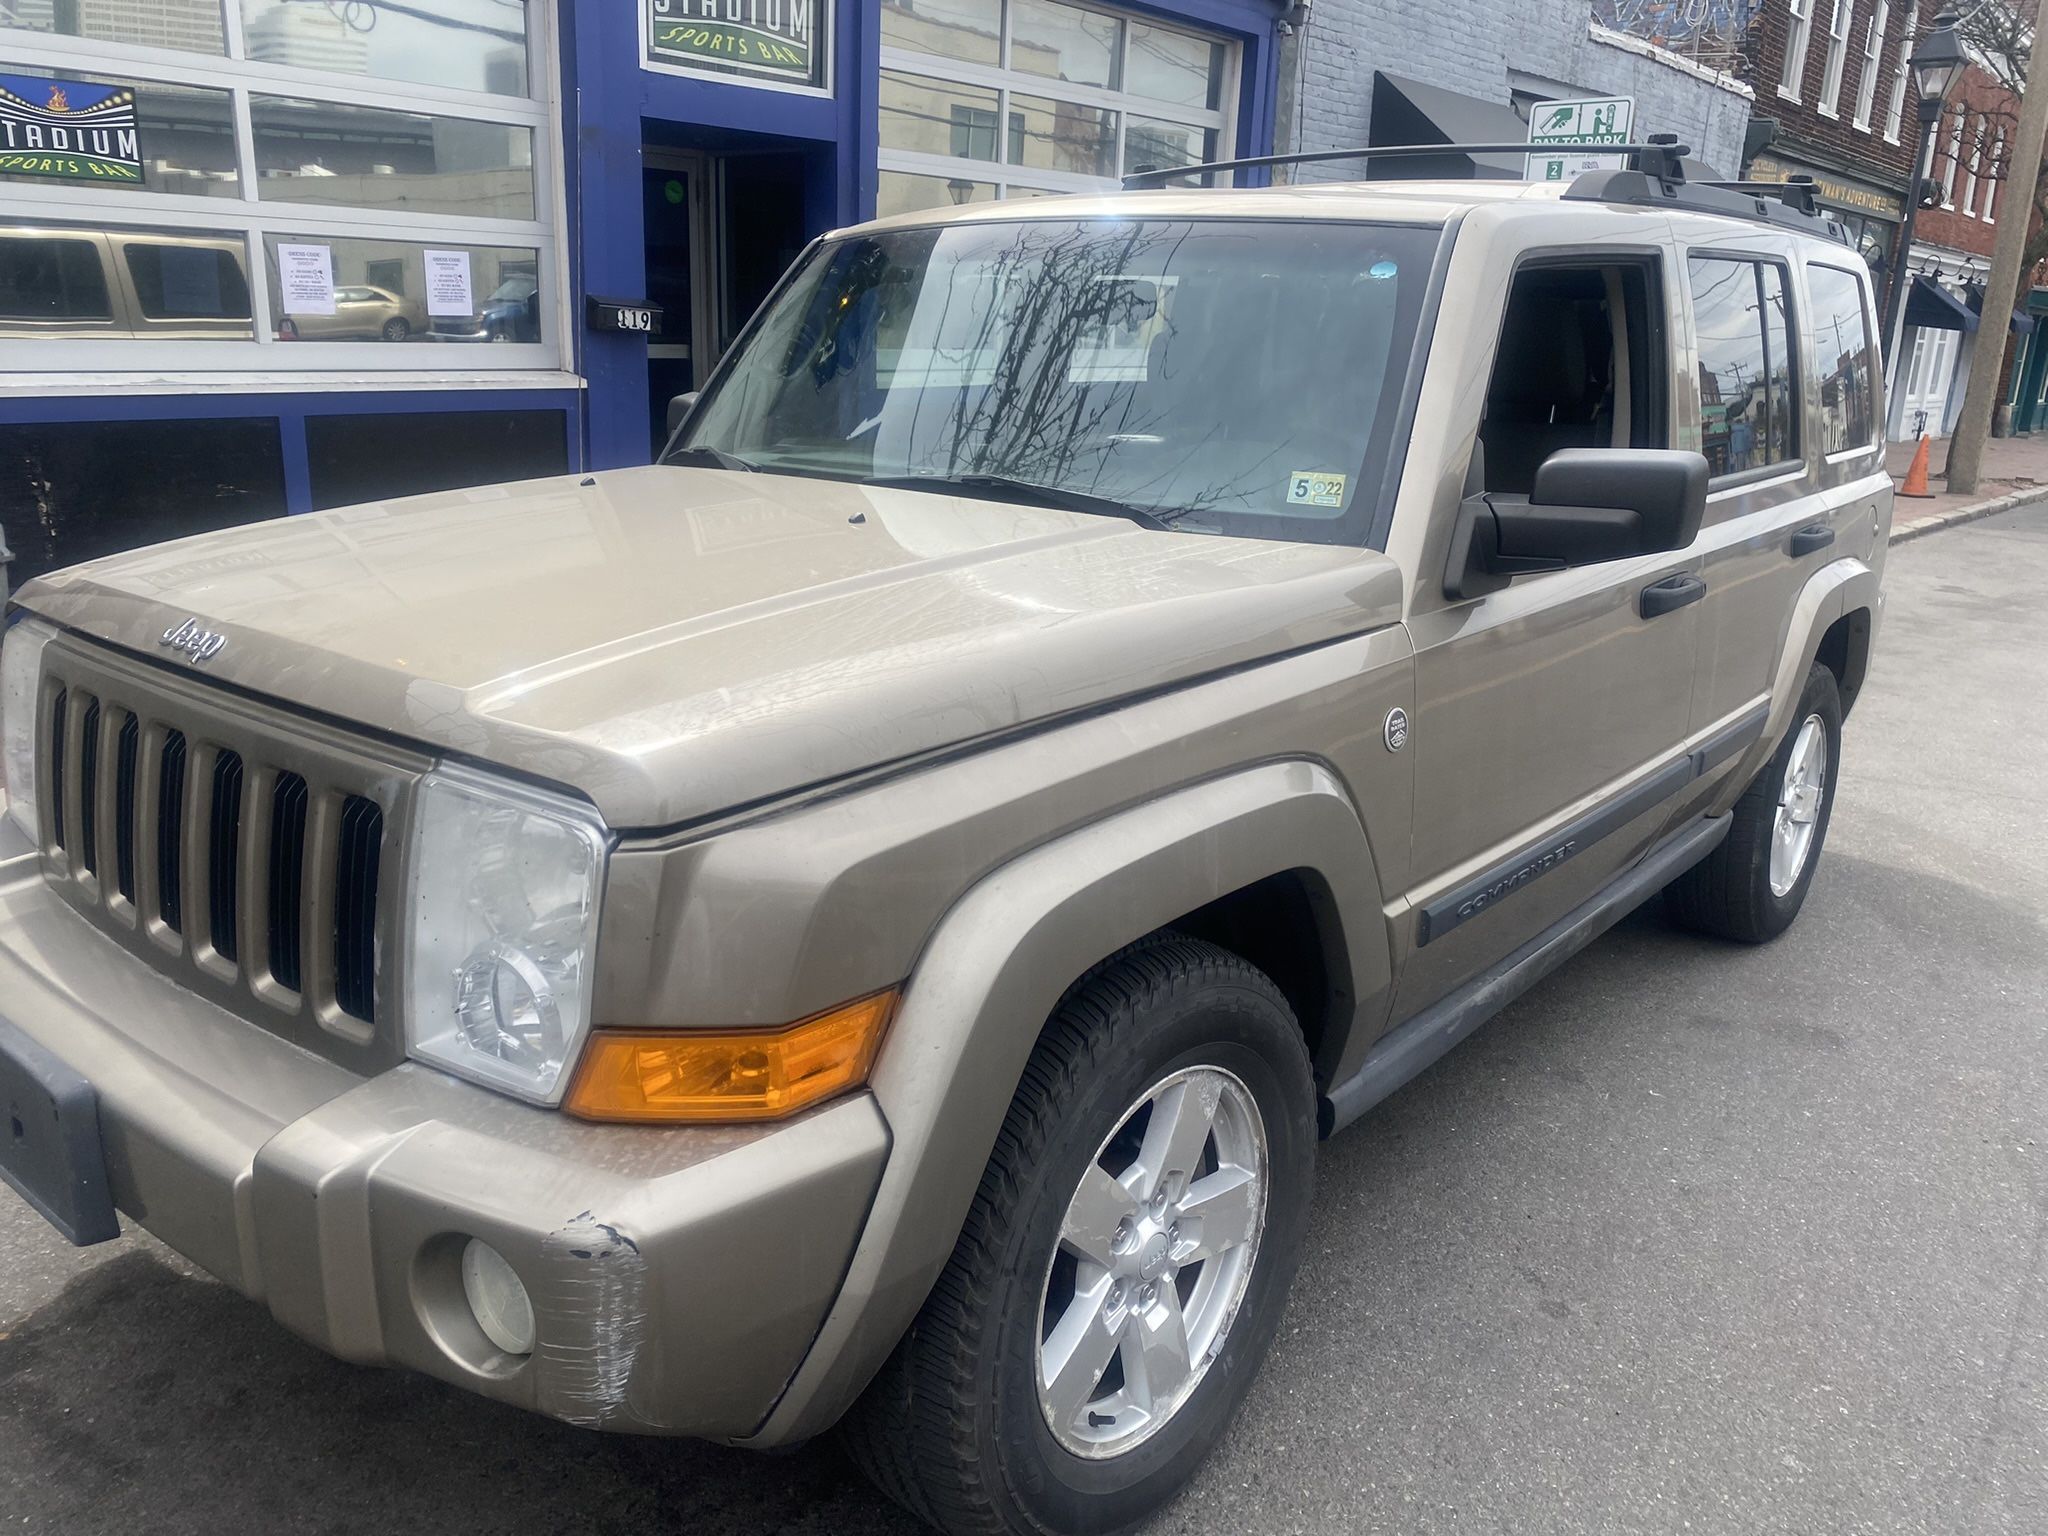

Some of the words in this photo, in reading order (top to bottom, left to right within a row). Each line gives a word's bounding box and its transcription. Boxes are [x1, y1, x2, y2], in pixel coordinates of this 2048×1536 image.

[660, 27, 748, 55] SPORTS
[757, 41, 804, 65] BAR
[0, 120, 139, 160] TADIUM
[1585, 135, 1623, 144] PARK
[0, 156, 79, 173] SPORTS
[88, 162, 137, 177] BAR
[1551, 165, 1558, 176] 2
[620, 310, 649, 329] 119
[1295, 479, 1309, 497] 5
[1325, 481, 1342, 496] 22
[160, 617, 225, 664] Jeep
[1457, 841, 1576, 918] COMMANDER
